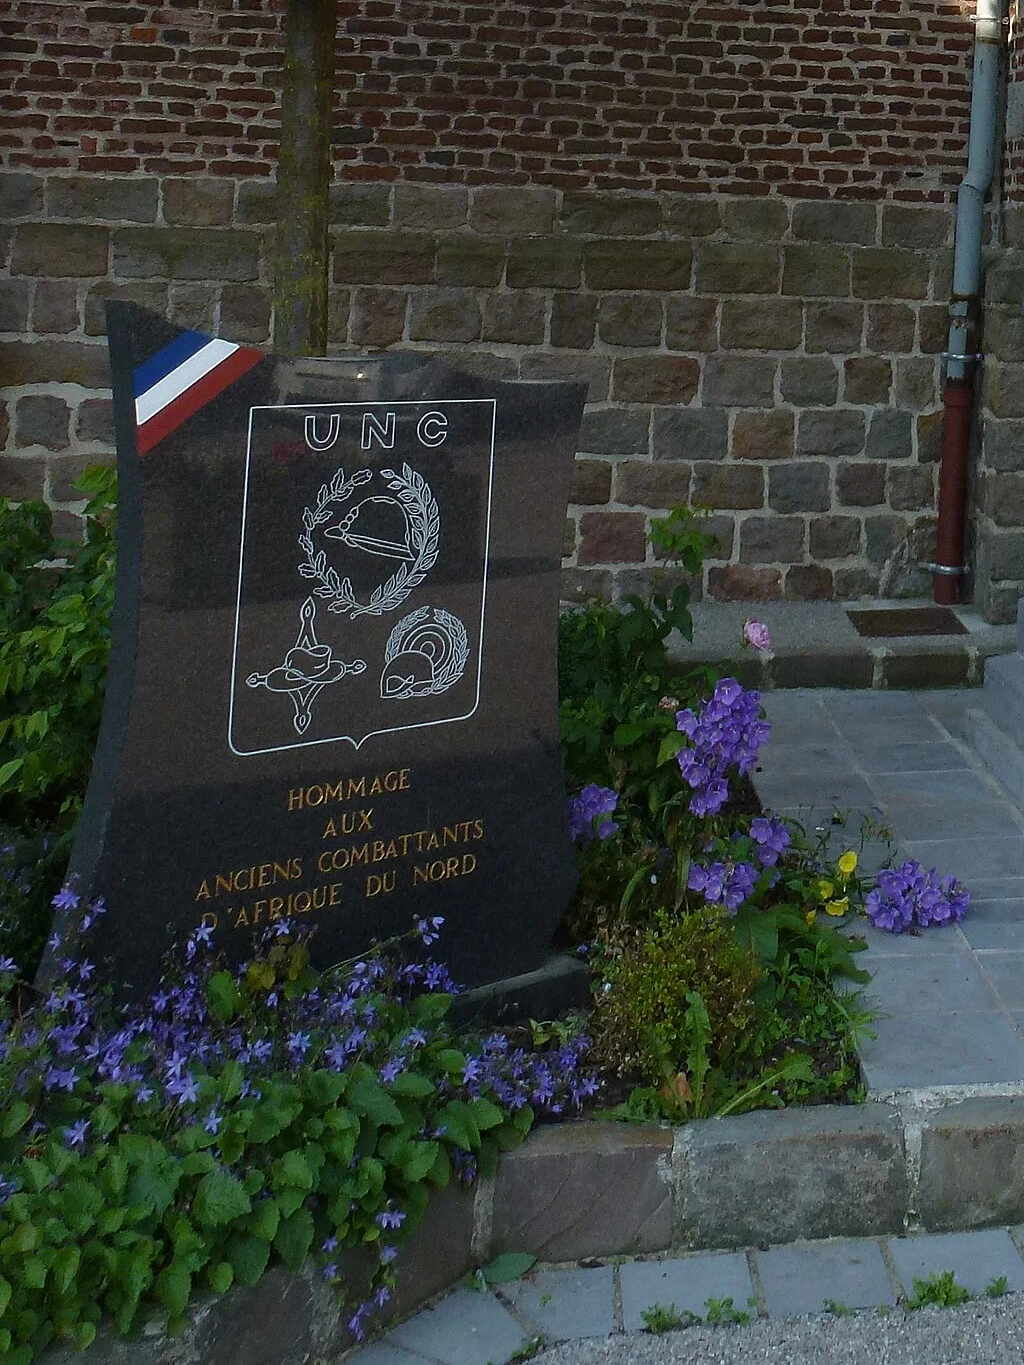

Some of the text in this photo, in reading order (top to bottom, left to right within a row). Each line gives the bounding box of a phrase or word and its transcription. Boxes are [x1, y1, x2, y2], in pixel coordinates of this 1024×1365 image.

[287, 768, 411, 812] HOMMAGE
[322, 808, 375, 840] AUX
[194, 819, 484, 901] ANCIENS COMBATTANTS
[365, 870, 396, 898] DU
[412, 854, 478, 885] NORD
